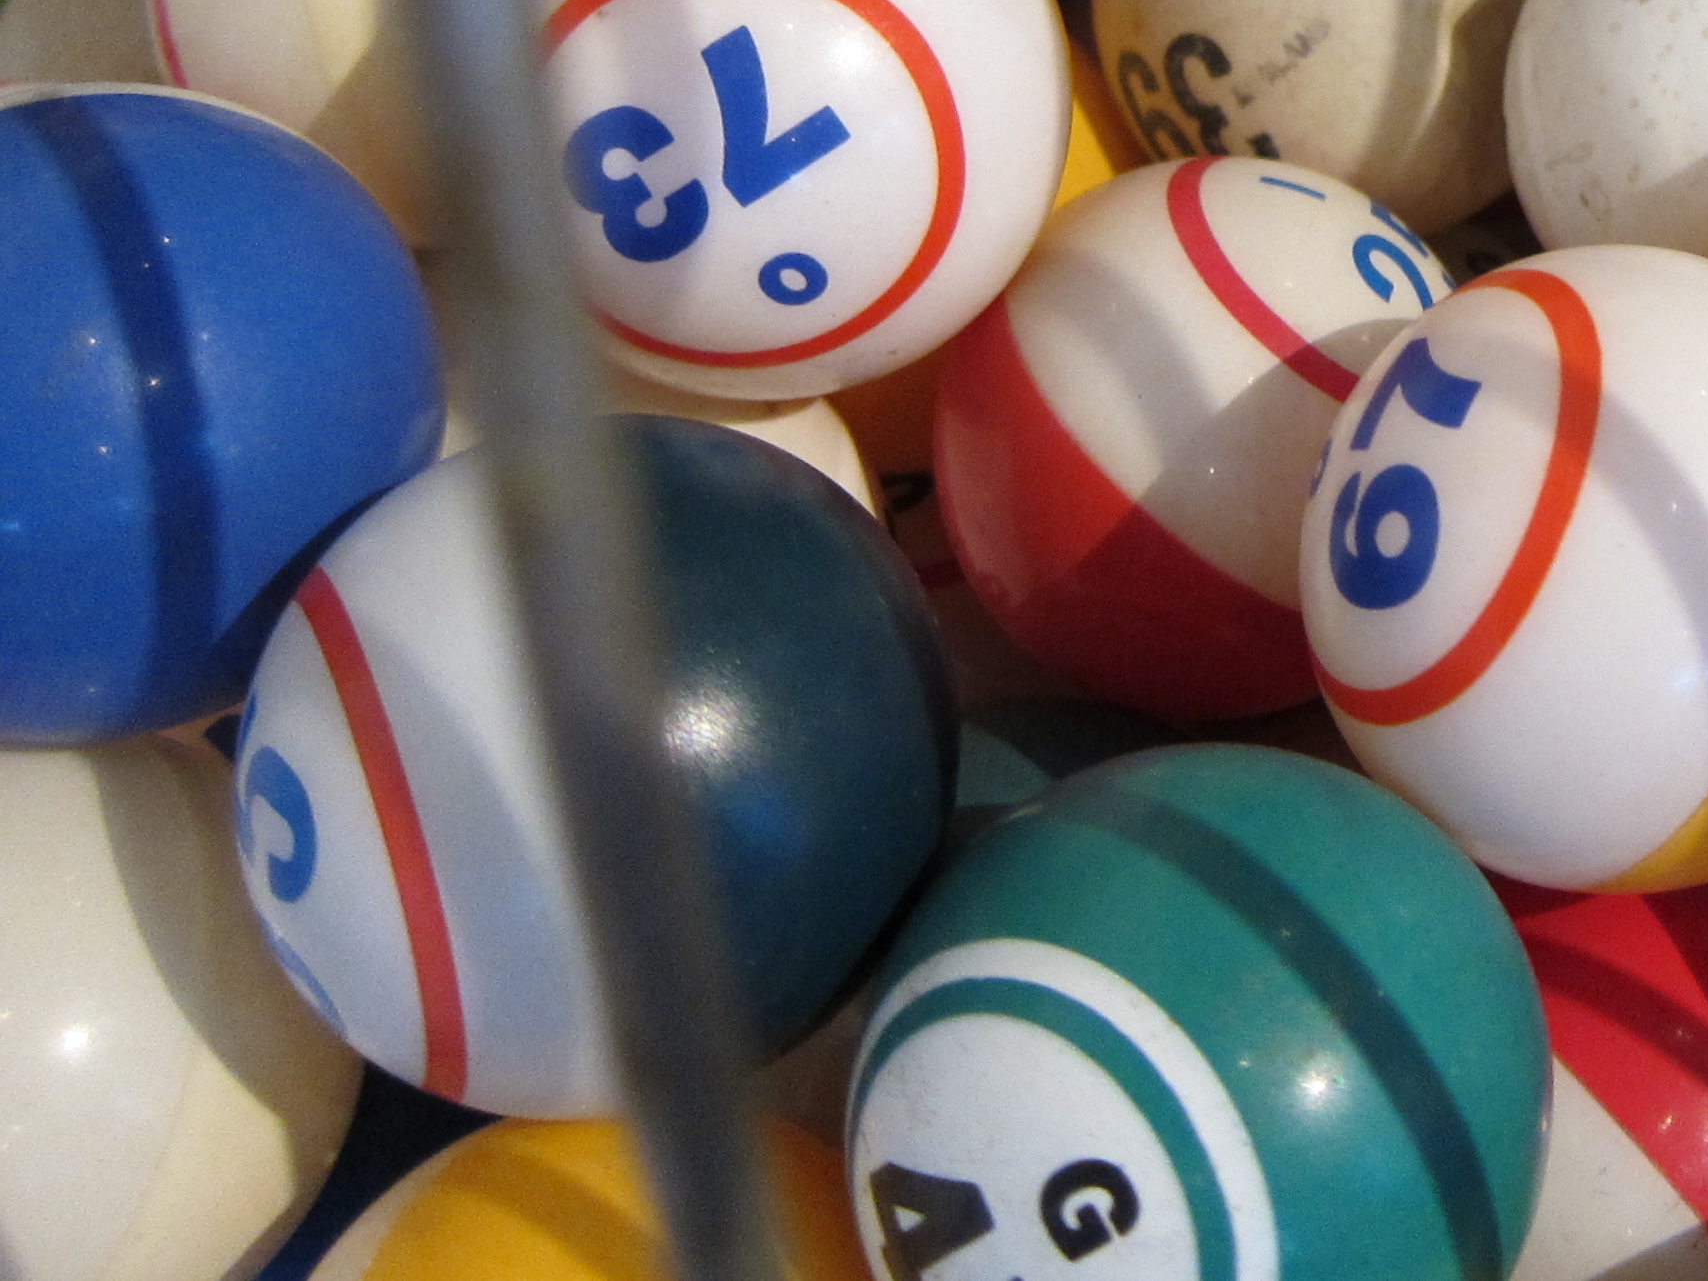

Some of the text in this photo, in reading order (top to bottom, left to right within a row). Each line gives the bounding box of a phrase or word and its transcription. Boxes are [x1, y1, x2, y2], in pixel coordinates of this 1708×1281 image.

[561, 25, 851, 263] 73
[758, 251, 828, 306] O
[1329, 338, 1482, 610] 67
[1039, 1158, 1140, 1262] G
